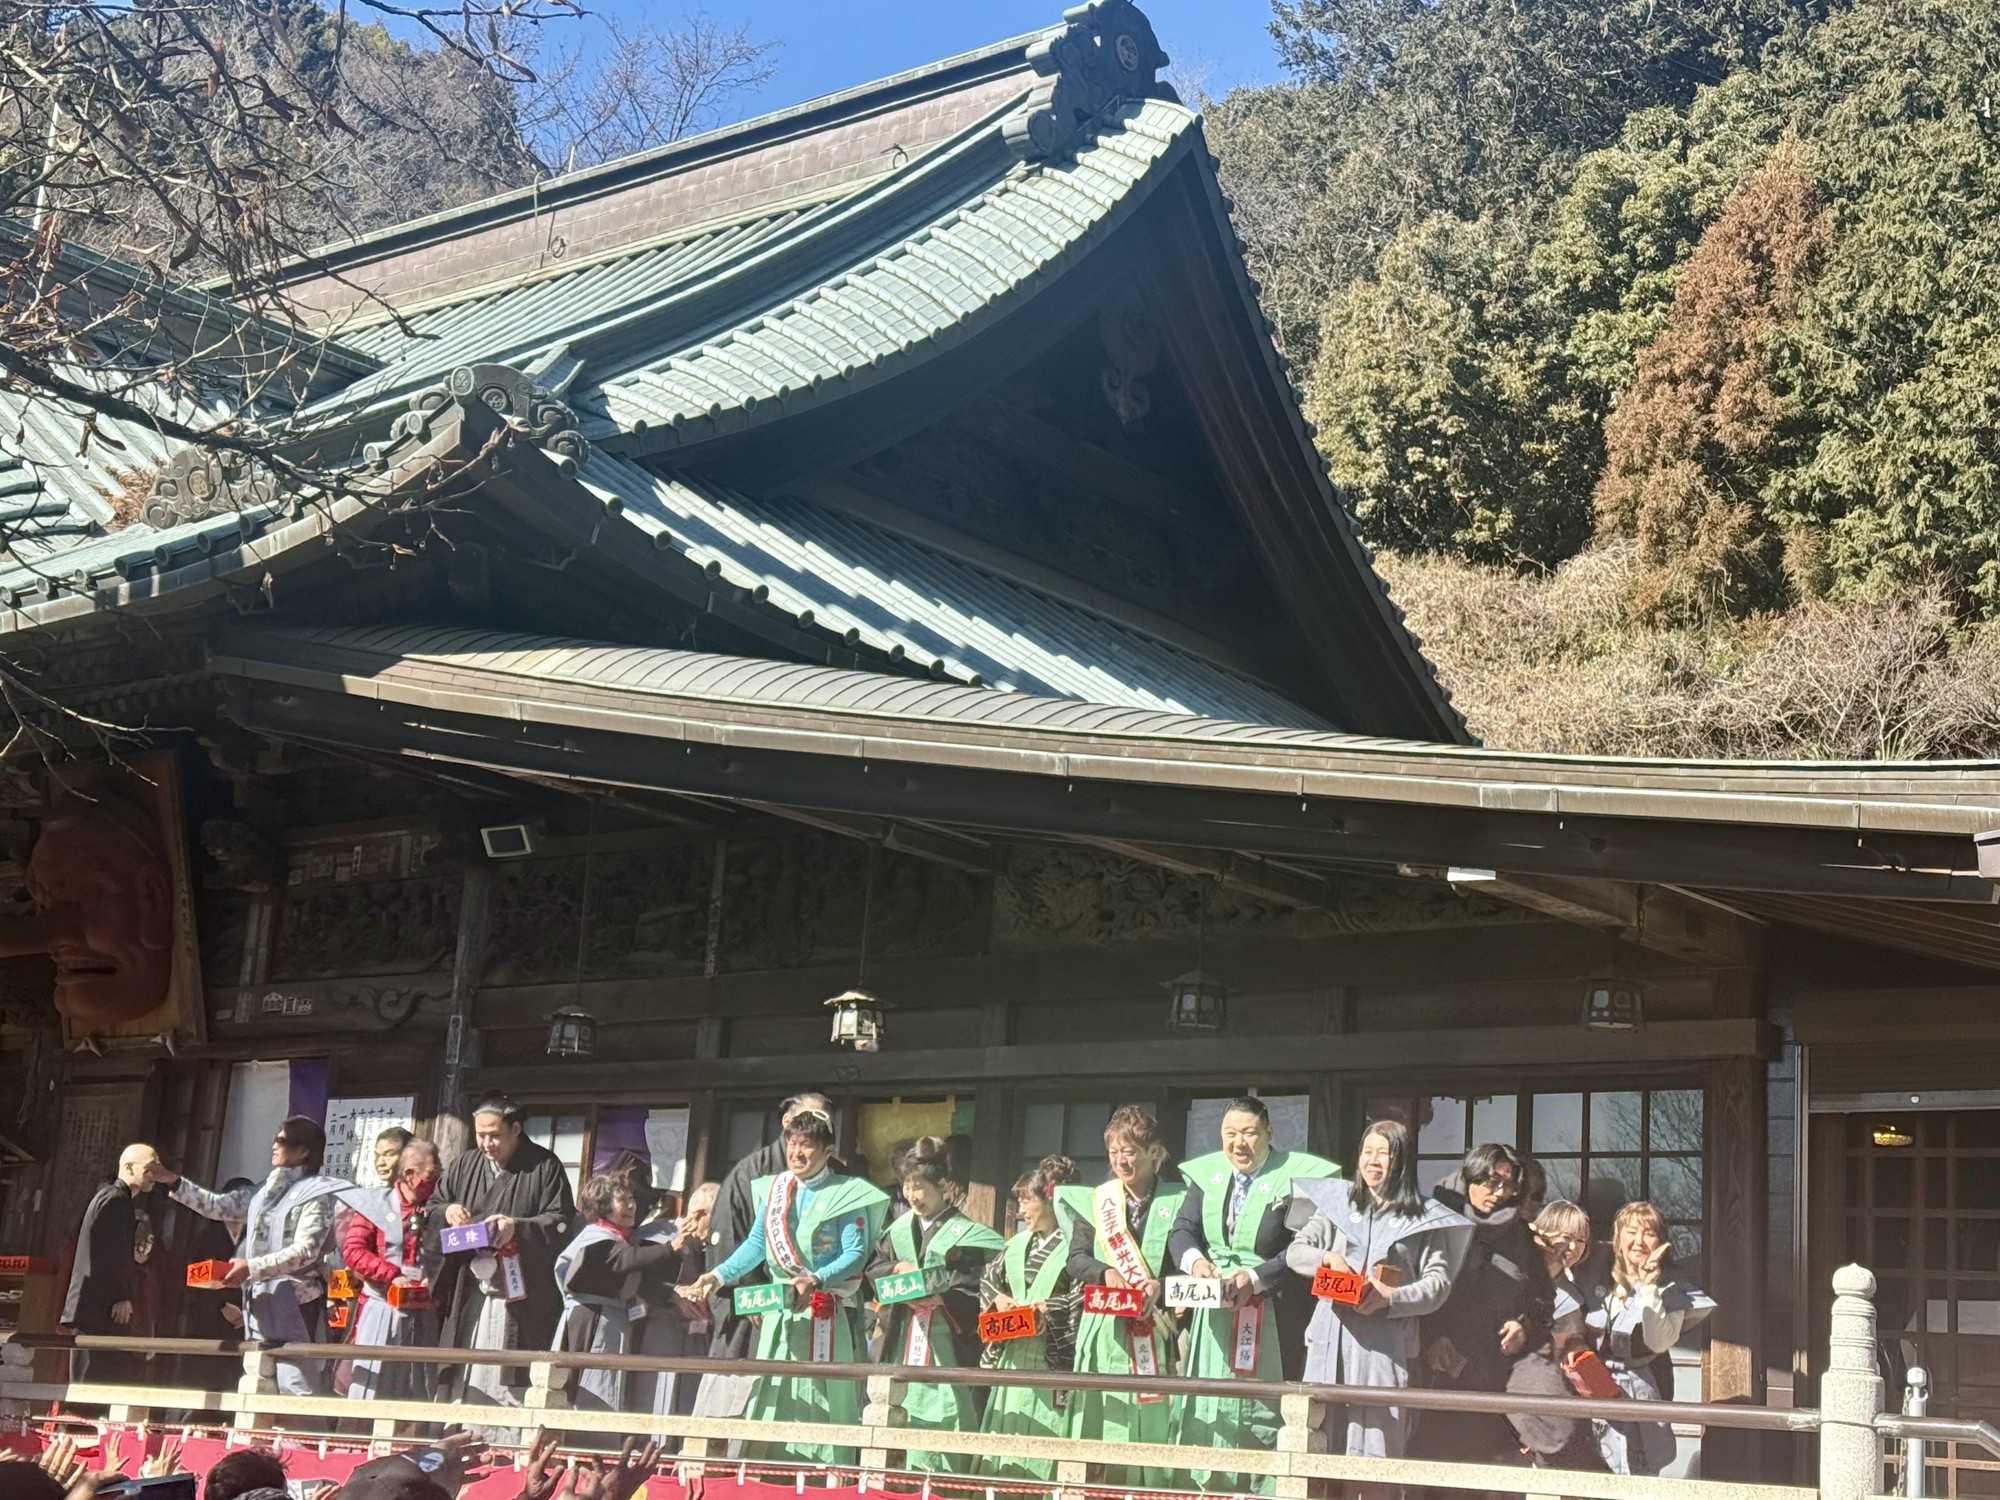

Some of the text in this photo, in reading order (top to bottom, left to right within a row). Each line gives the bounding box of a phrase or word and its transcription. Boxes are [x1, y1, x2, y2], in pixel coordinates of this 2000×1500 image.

[447, 1229, 479, 1247] 厄除
[1101, 1197, 1144, 1286] 八王子観光大
